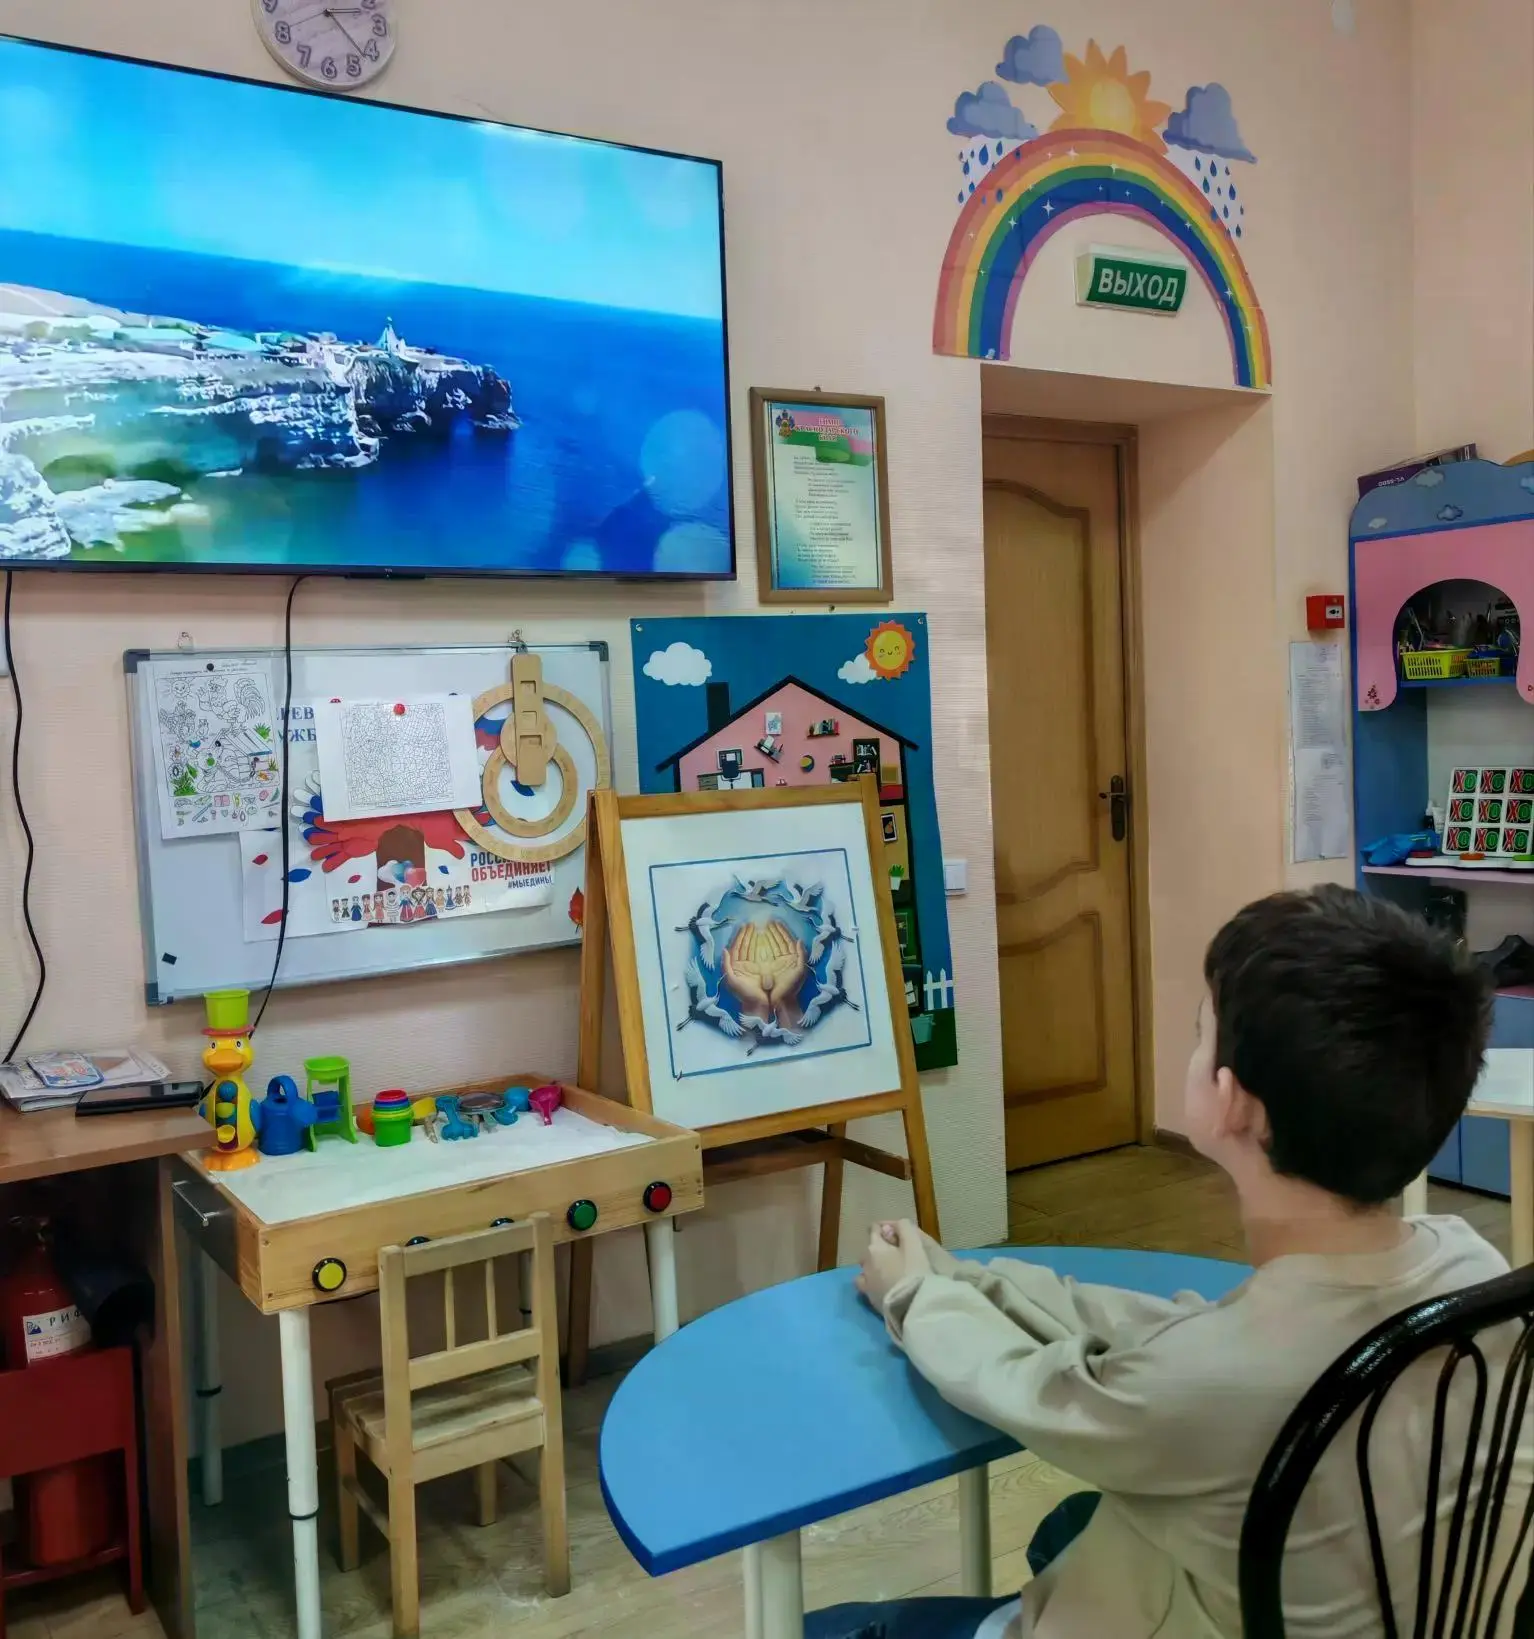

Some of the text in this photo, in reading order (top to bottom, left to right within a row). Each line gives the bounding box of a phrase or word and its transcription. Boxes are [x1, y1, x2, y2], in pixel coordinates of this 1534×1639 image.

[275, 21, 291, 44] 8
[372, 14, 386, 37] 3
[297, 45, 312, 68] 7
[364, 39, 379, 62] 4
[321, 56, 337, 79] 6
[347, 53, 361, 77] 5
[1098, 268, 1179, 307] ВЫХОД
[471, 860, 551, 882] ОБЪЕДИНЯЕТ
[507, 875, 552, 889] #МЫЕДИНЫ
